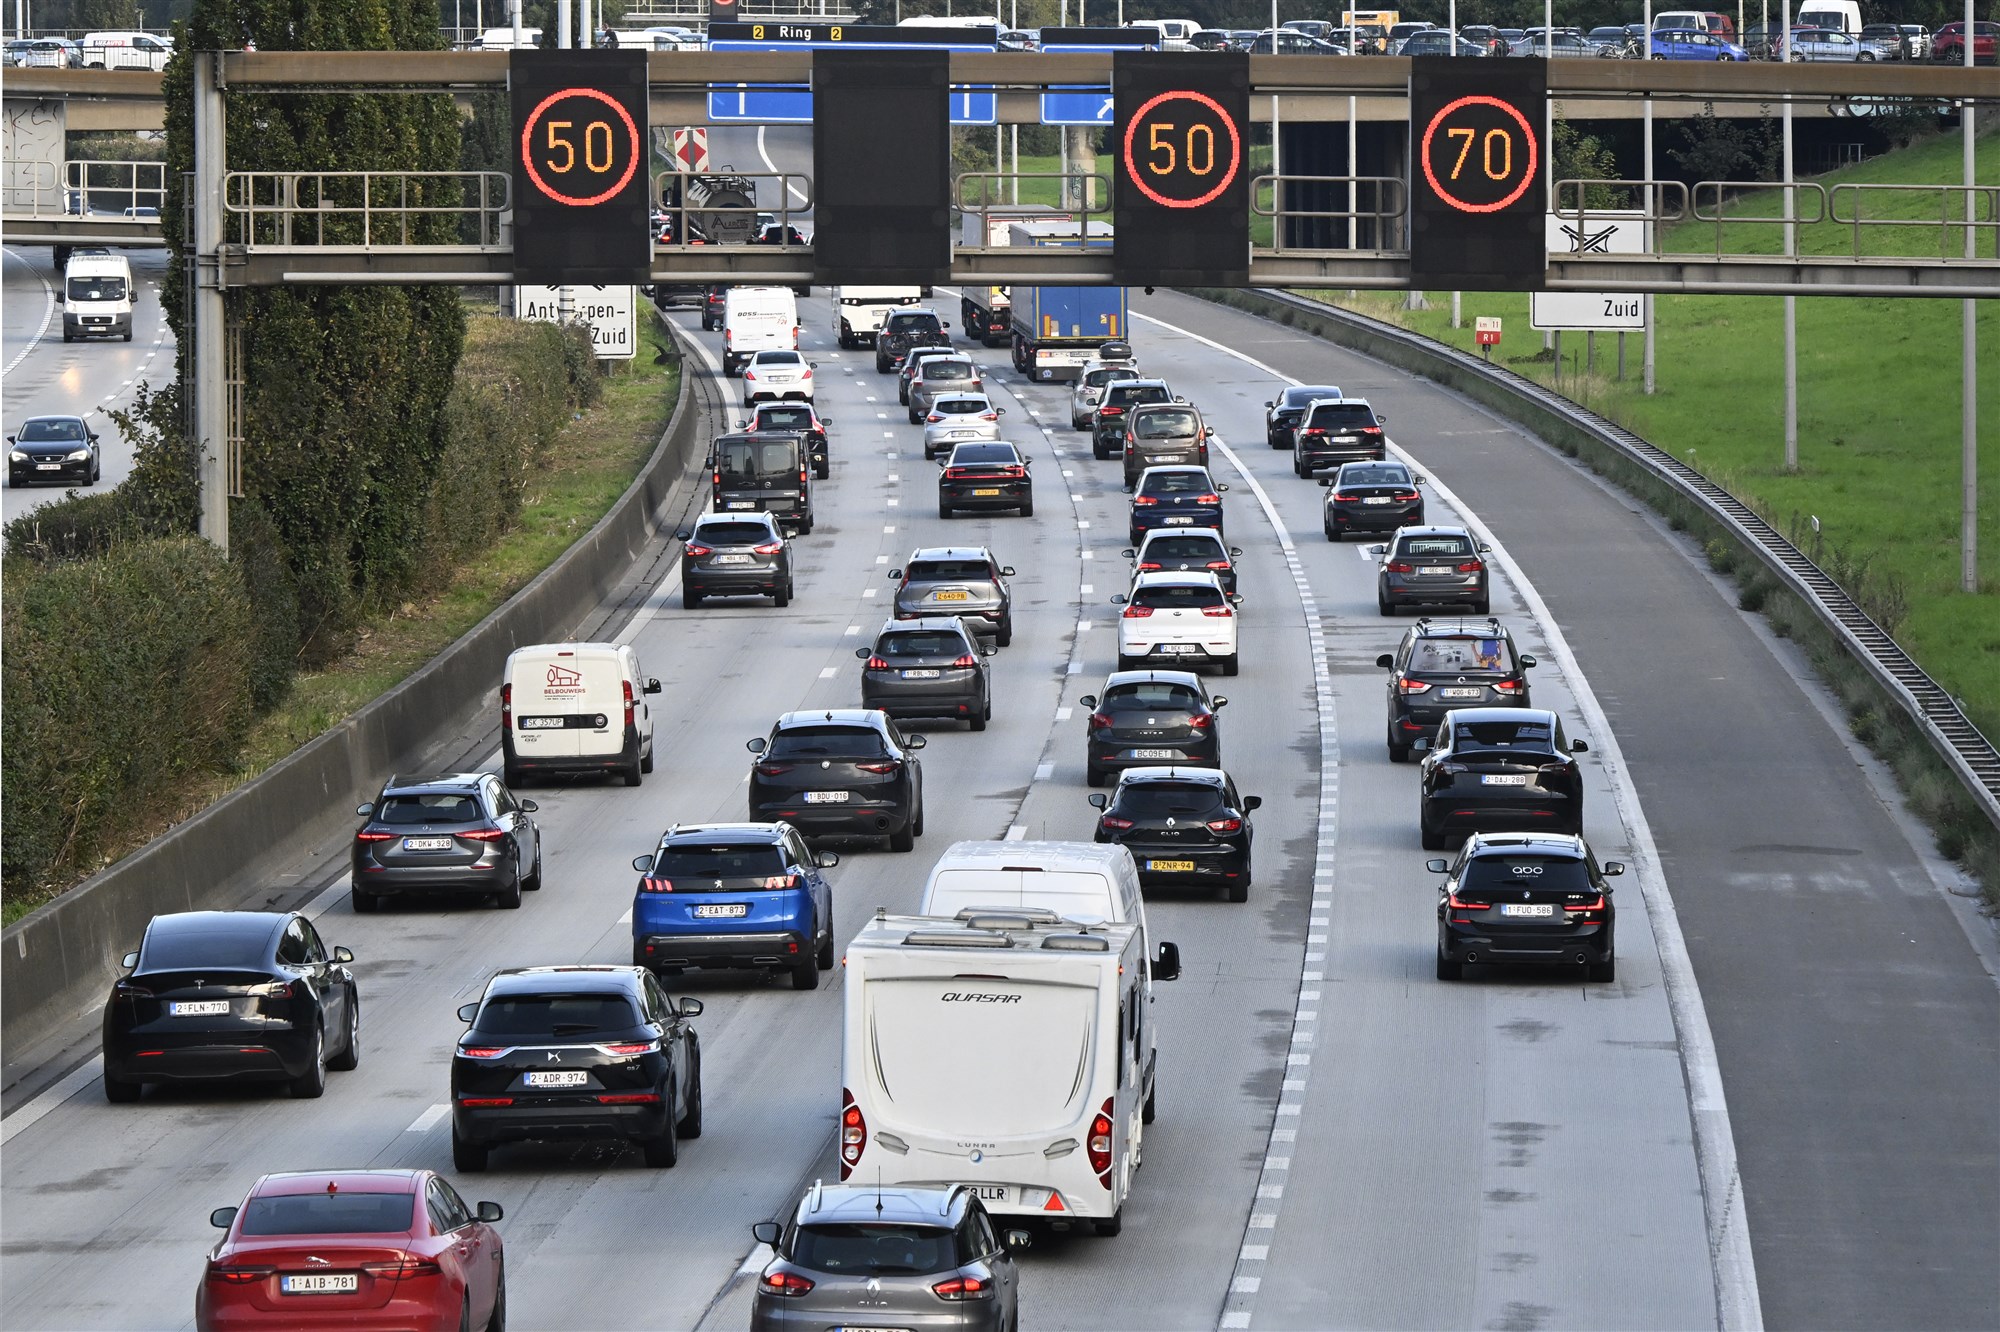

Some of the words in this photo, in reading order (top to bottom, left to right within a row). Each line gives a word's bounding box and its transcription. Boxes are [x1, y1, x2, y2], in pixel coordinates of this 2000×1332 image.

[754, 27, 762, 38] 2
[780, 26, 811, 40] Ring
[832, 28, 840, 39] 2
[546, 121, 613, 173] 50
[1149, 123, 1215, 176] 50
[1447, 128, 1511, 180] 70
[1604, 299, 1639, 317] Zuid
[1492, 320, 1499, 328] 11
[592, 327, 626, 344] Zuid
[528, 719, 537, 727] SK
[941, 992, 1022, 1004] QUASAR
[980, 1188, 1004, 1200] LLR
